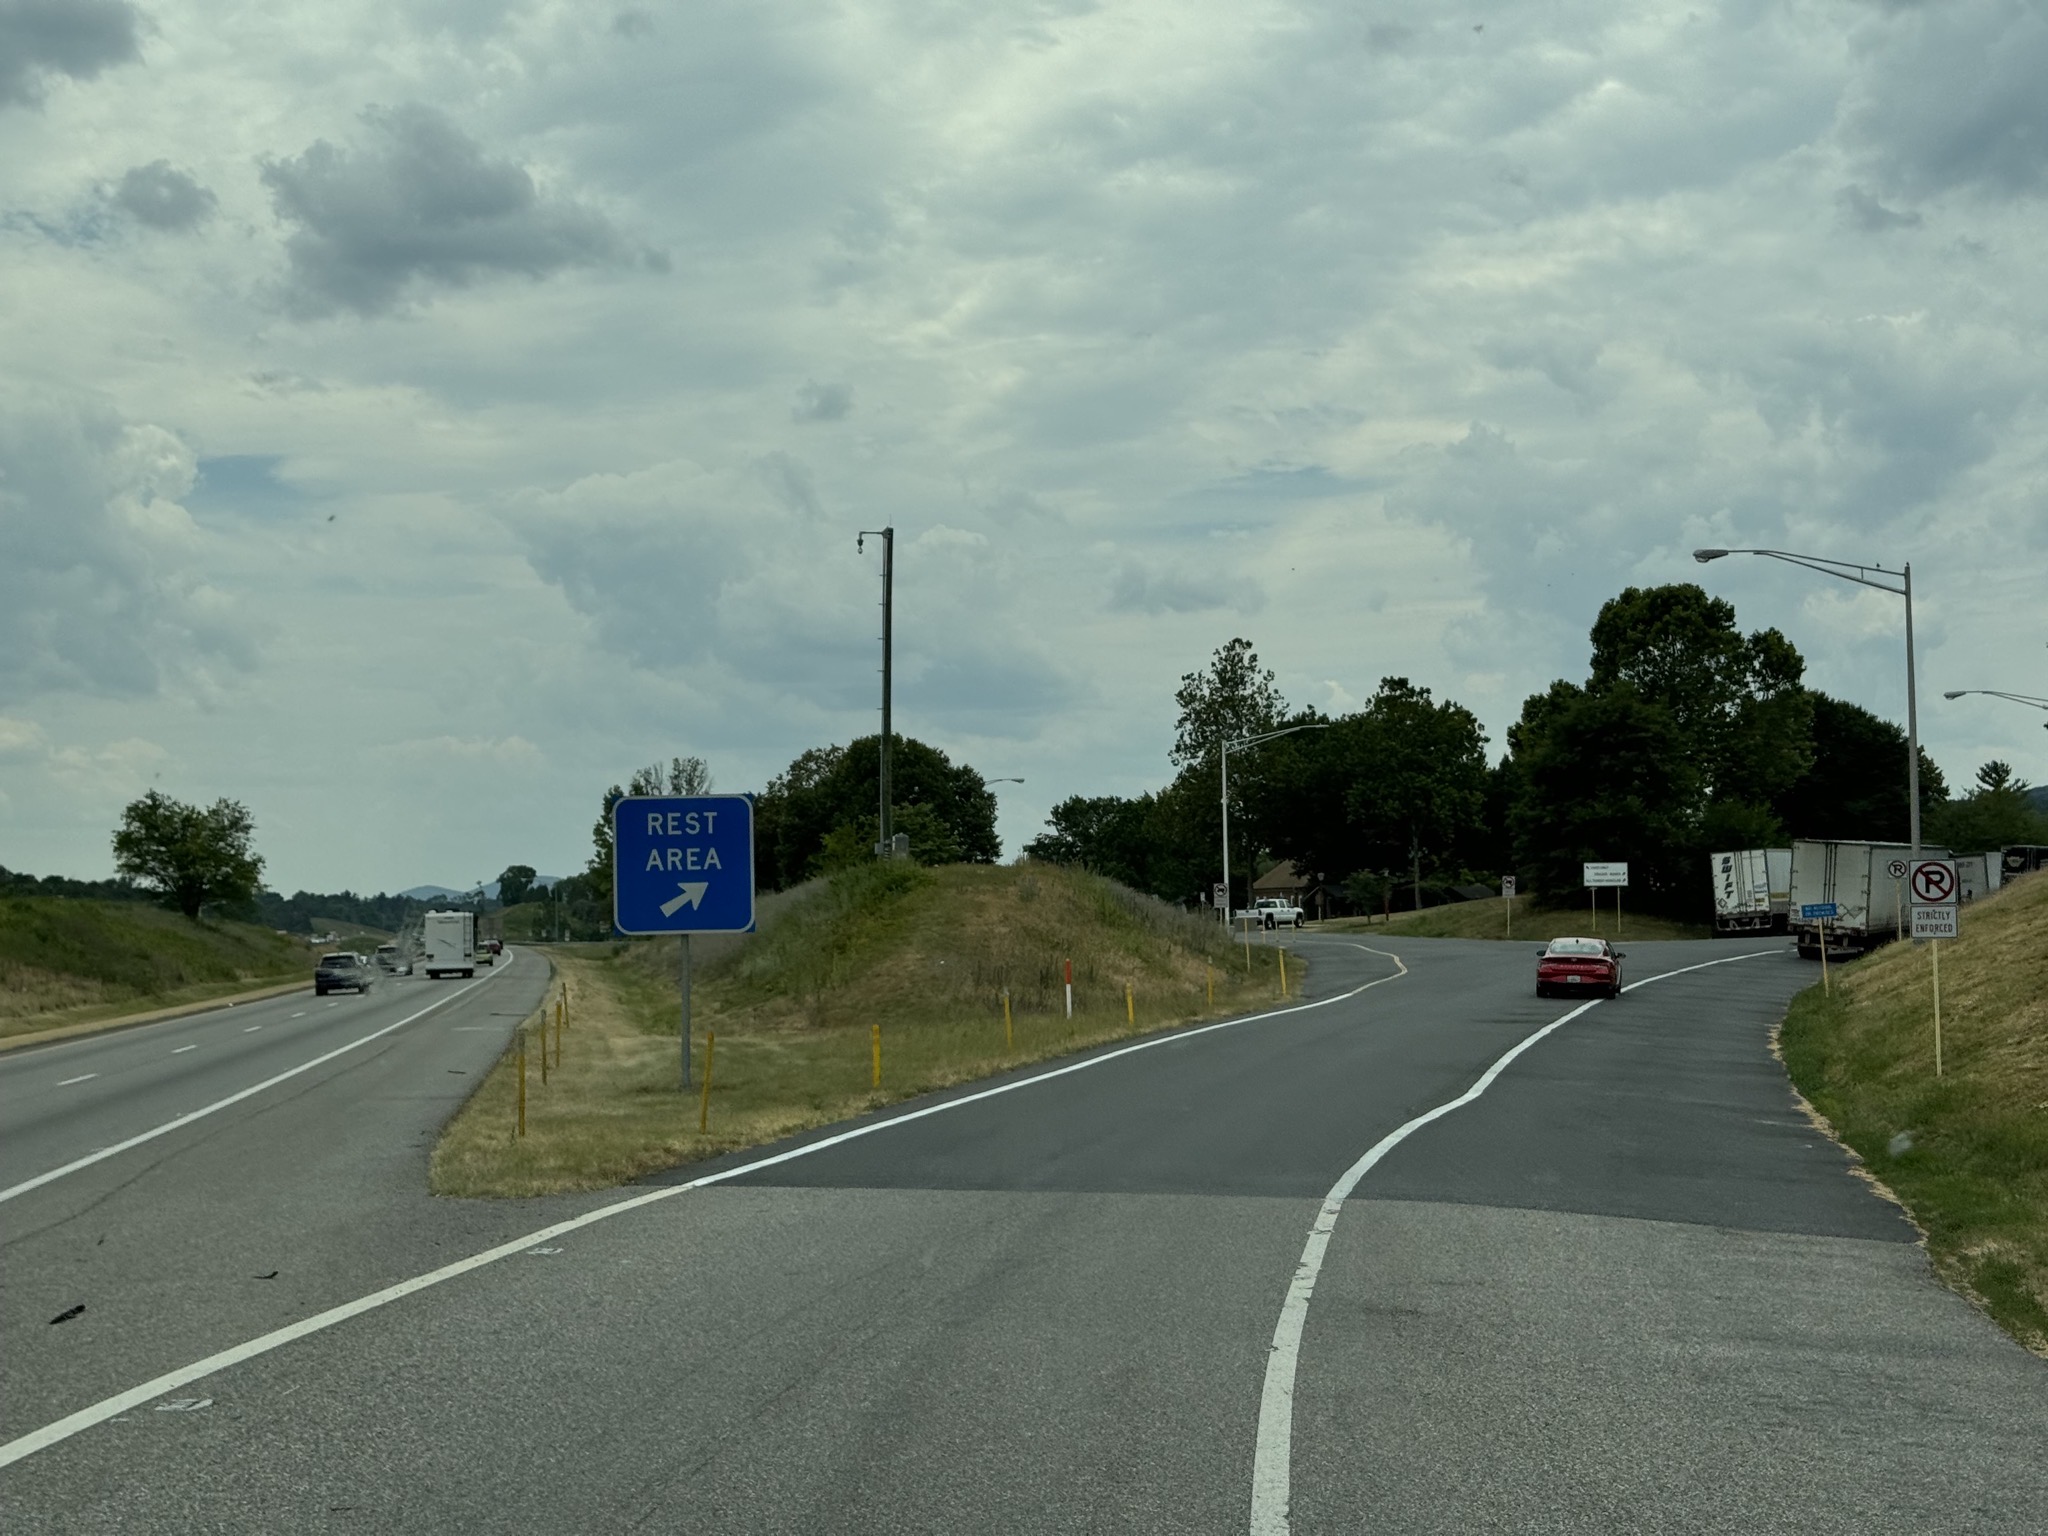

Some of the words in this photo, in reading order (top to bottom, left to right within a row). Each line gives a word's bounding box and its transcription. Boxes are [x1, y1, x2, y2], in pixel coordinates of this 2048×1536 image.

[647, 811, 718, 835] REST
[645, 847, 722, 871] AREA
[1721, 856, 1735, 899] SWIFT
[1917, 910, 1951, 920] STRICTLY
[1915, 923, 1953, 934] ENFORCED
